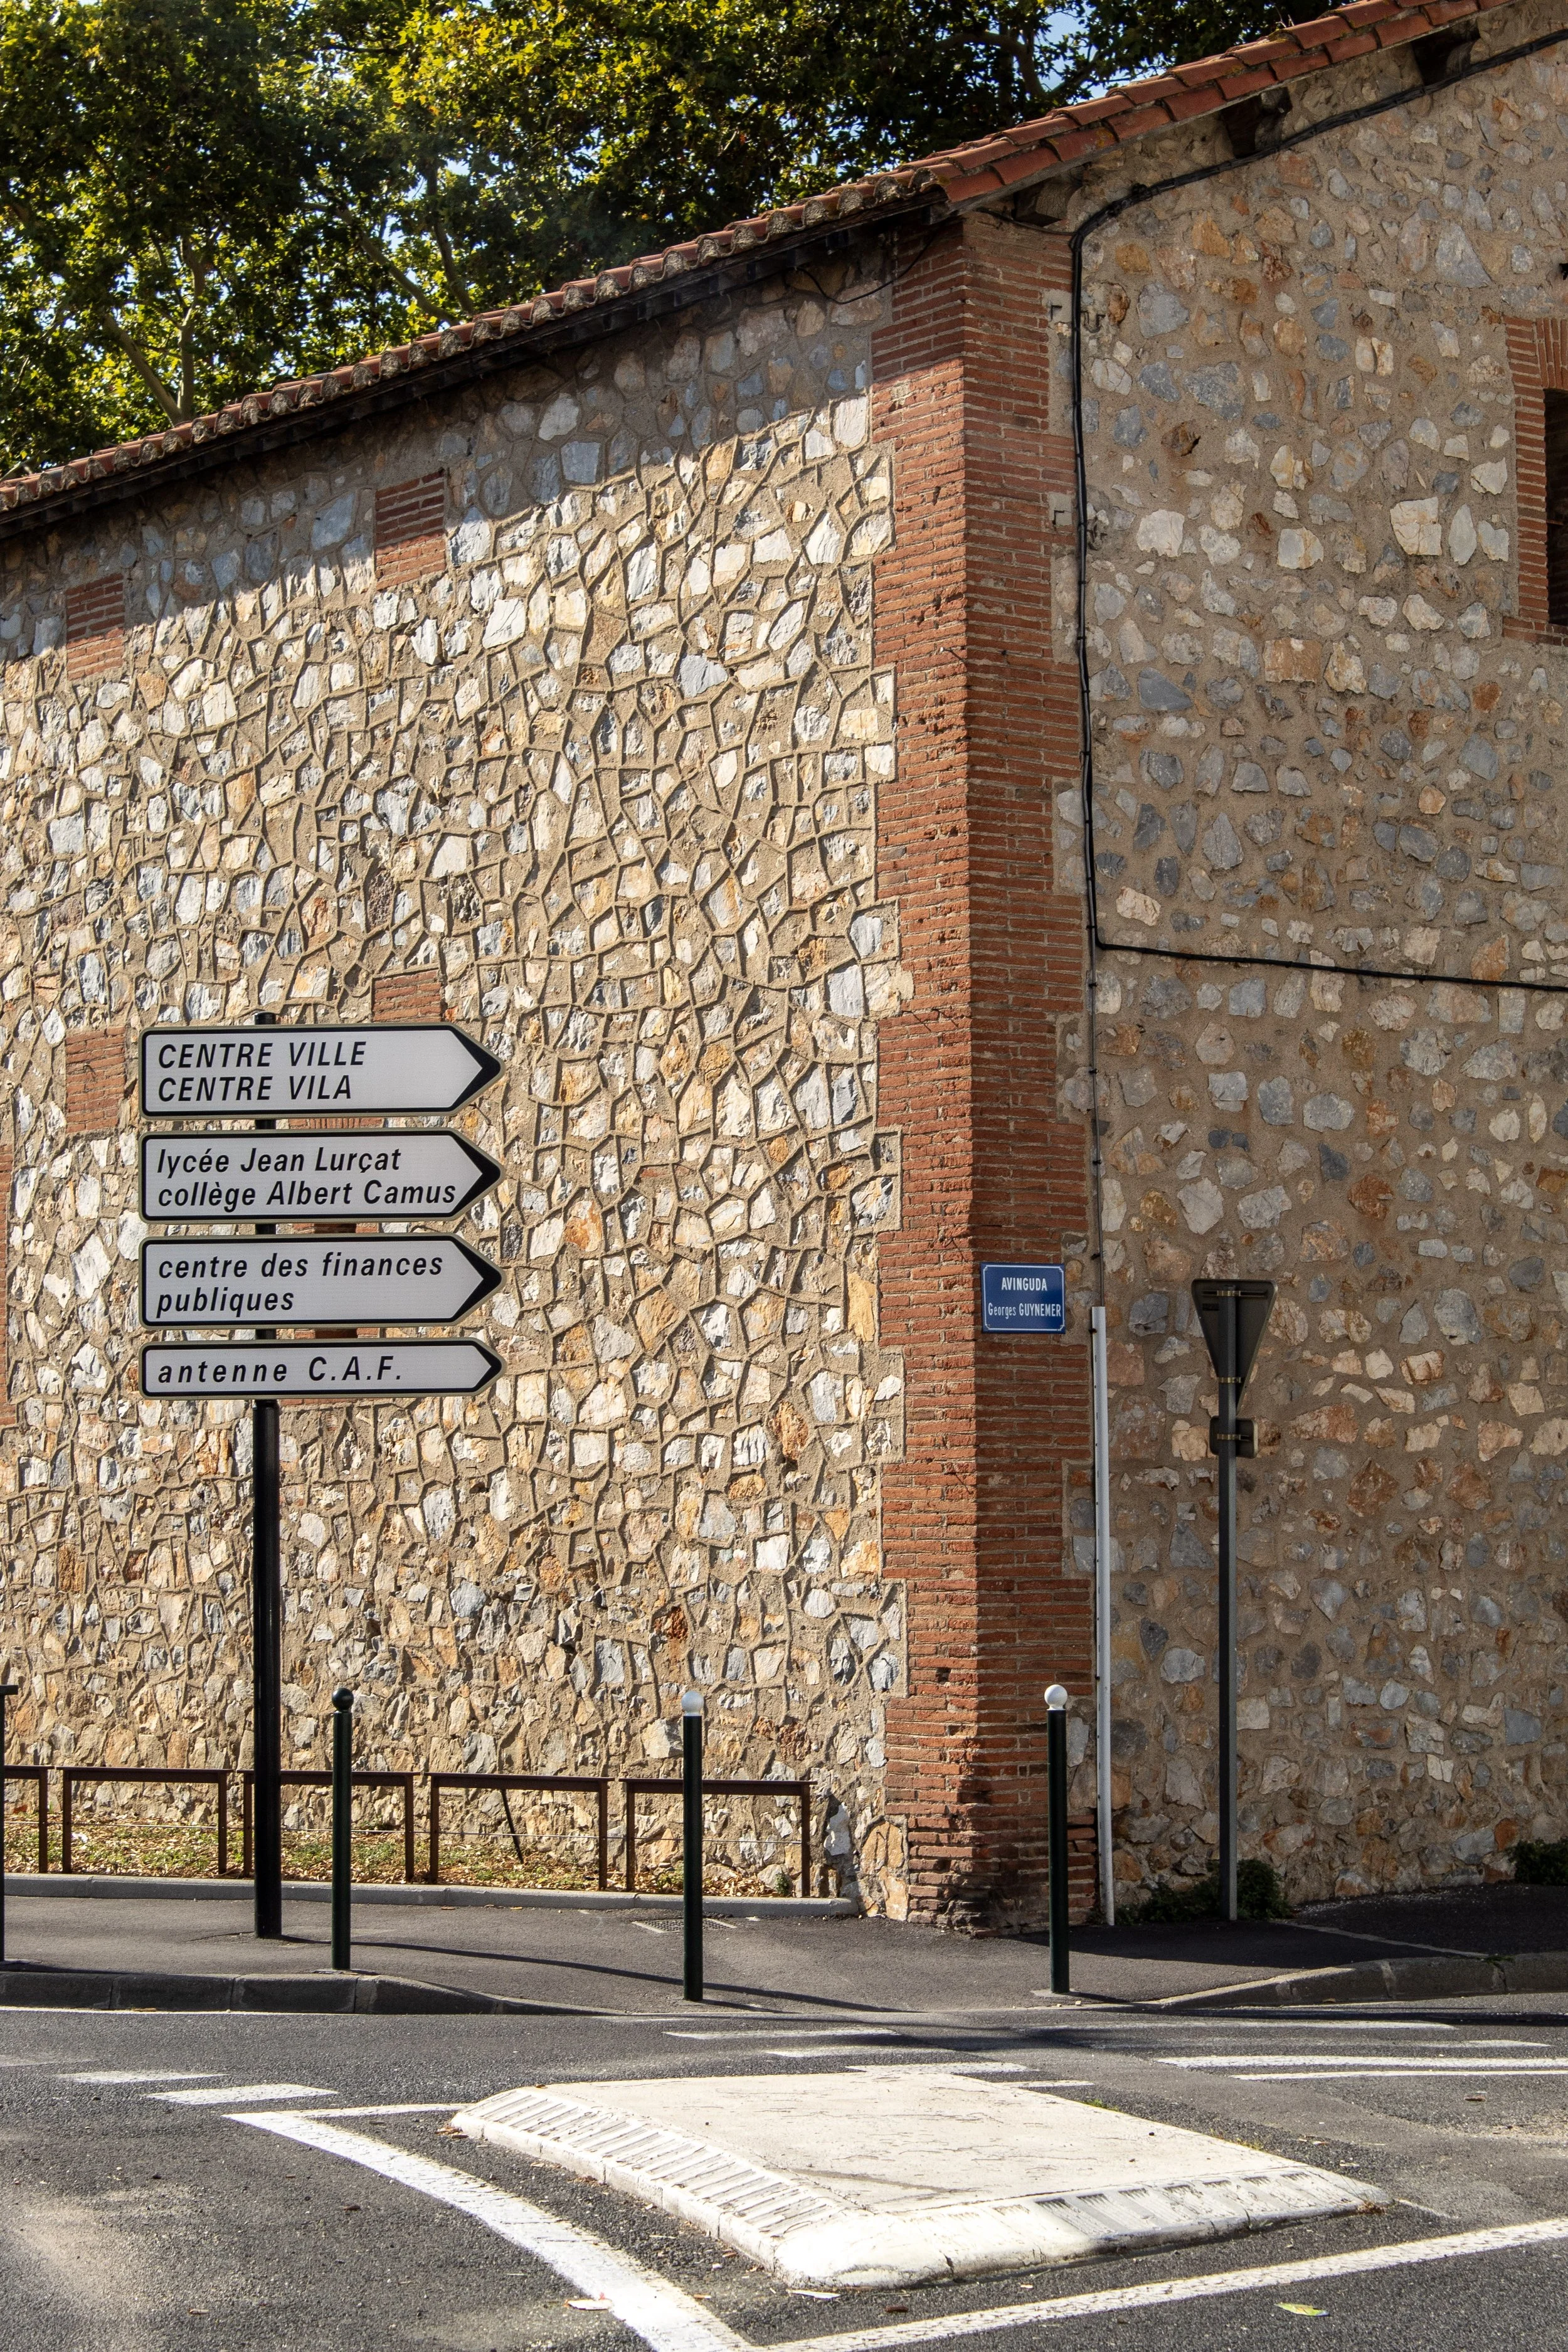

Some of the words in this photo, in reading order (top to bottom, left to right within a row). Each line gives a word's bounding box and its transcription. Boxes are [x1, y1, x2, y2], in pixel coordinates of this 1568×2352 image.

[158, 1042, 273, 1069] CENTRE
[289, 1041, 366, 1066] VILLE
[158, 1076, 273, 1102] CENTRE
[289, 1074, 352, 1100] VILA
[157, 1148, 230, 1179] lycée
[240, 1147, 304, 1172] Jean
[315, 1147, 401, 1174] Lurçat
[158, 1182, 257, 1212] collège
[267, 1180, 352, 1205] Albert
[363, 1180, 456, 1204] Camus
[159, 1258, 248, 1278] centre
[261, 1253, 308, 1277] des
[322, 1252, 443, 1276] finances
[1001, 1277, 1047, 1291] AVINGUDA
[156, 1287, 294, 1318] publiques
[988, 1303, 1016, 1319] Georges
[1019, 1303, 1061, 1317] GUYNEMER
[158, 1360, 288, 1383] antenne
[309, 1355, 401, 1381] C.A.F.
